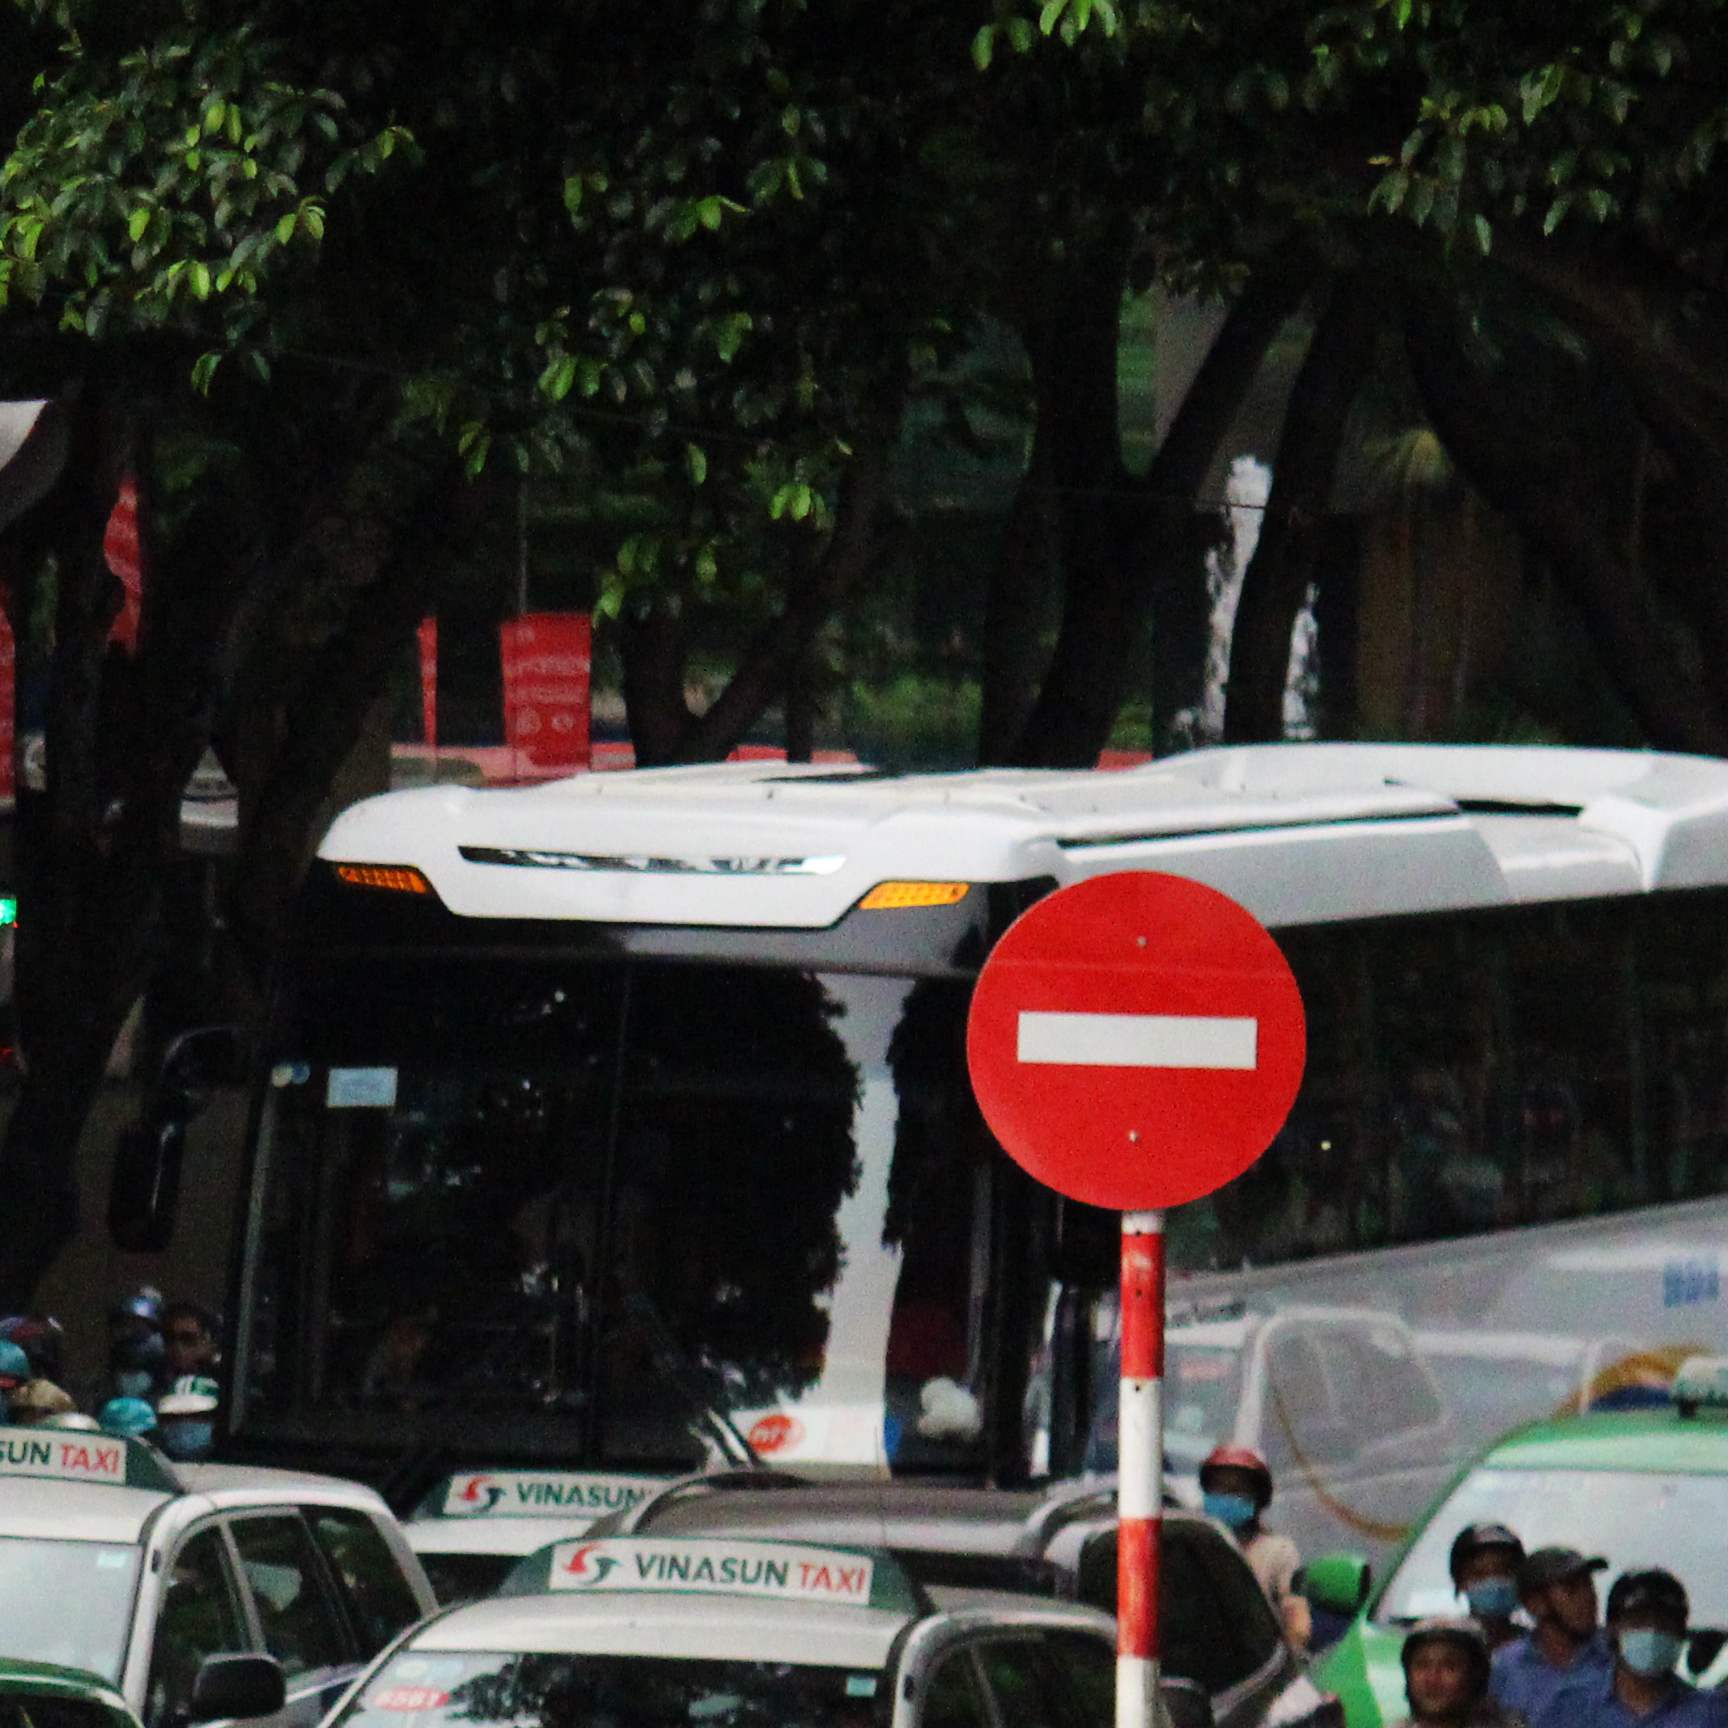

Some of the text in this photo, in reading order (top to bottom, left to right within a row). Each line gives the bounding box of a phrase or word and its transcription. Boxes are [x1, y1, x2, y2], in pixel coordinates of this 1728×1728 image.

[59, 1443, 121, 1474] TAXI
[516, 1482, 645, 1512] VINASUN
[635, 1552, 865, 1593] VINASUN TAXI
